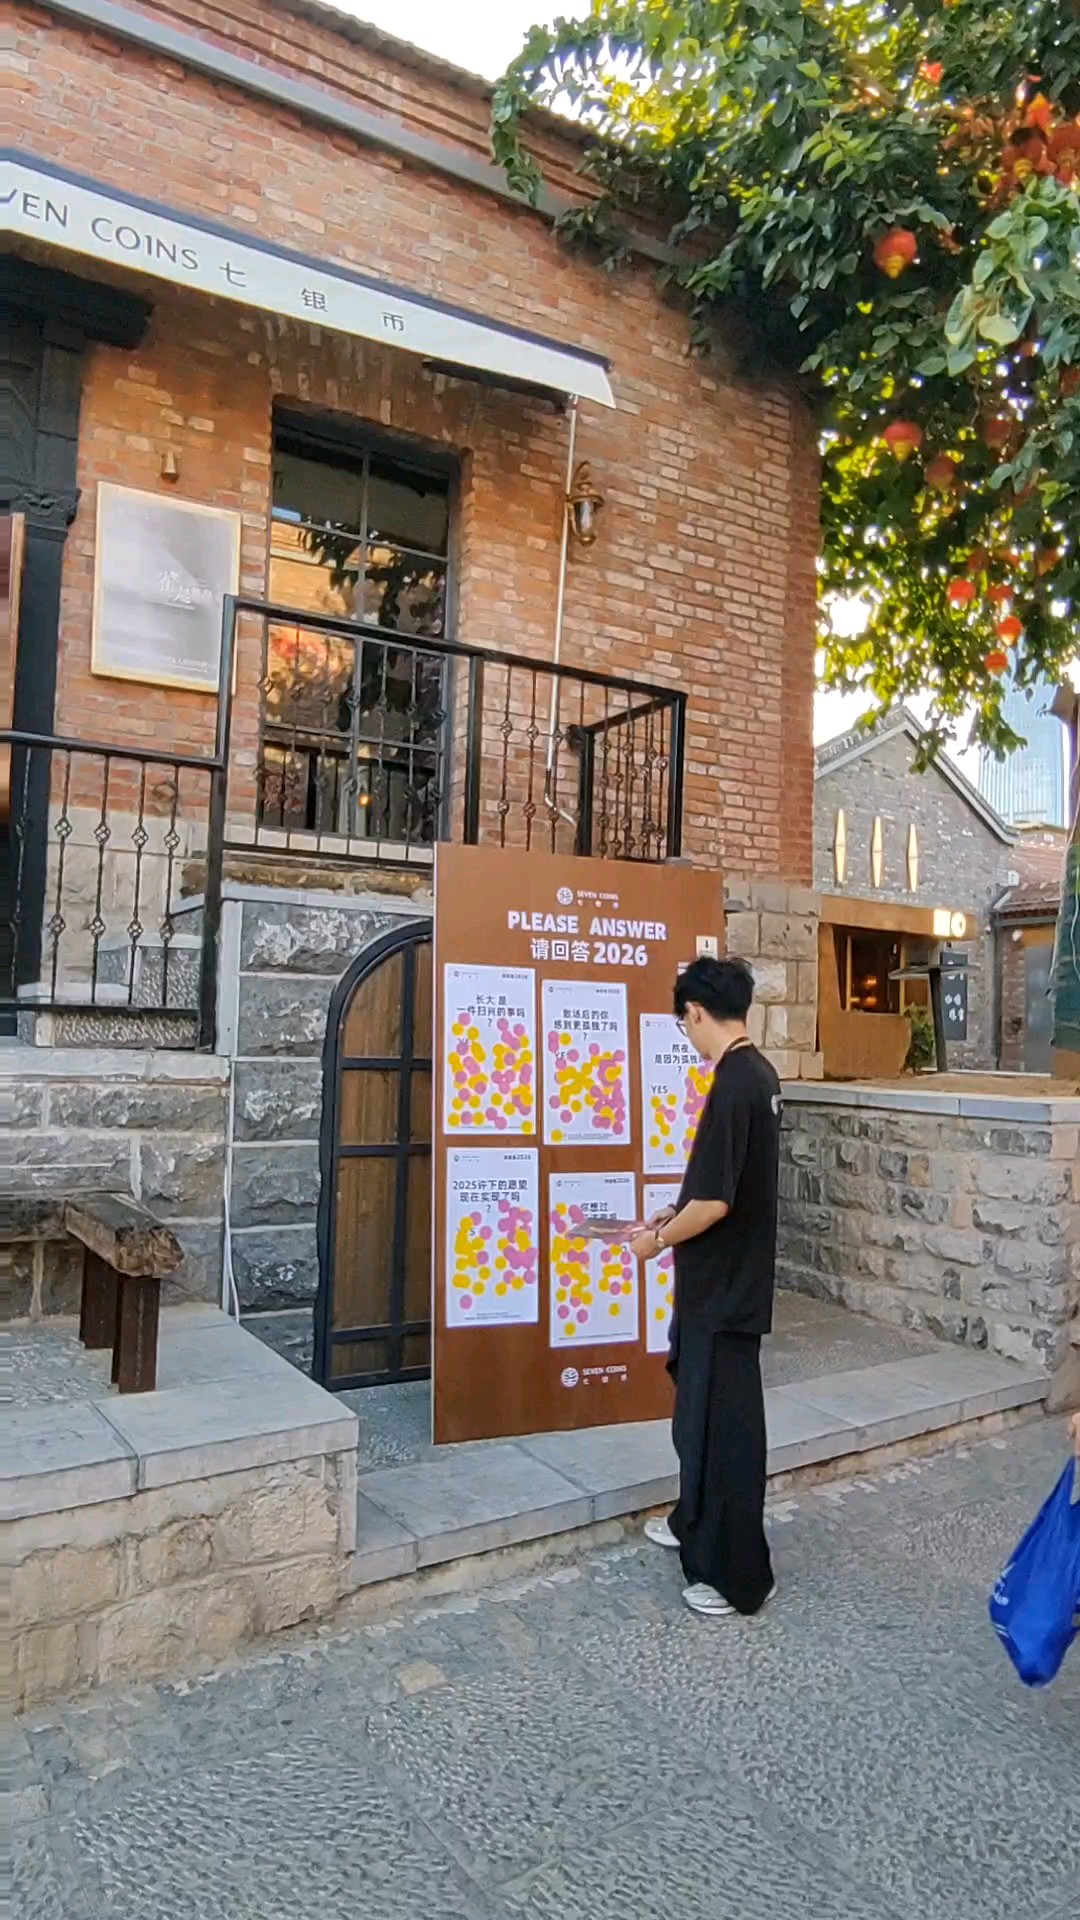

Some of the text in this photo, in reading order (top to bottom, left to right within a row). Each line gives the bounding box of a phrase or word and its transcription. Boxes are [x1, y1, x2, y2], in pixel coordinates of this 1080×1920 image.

[91, 217, 199, 270] COINS
[507, 910, 667, 940] PLEASE ANSWER
[530, 938, 648, 966] 请回答2026
[654, 1054, 703, 1064] 是因为孤独
[651, 1085, 668, 1094] YES
[453, 1180, 528, 1190] 2025许下的愿望
